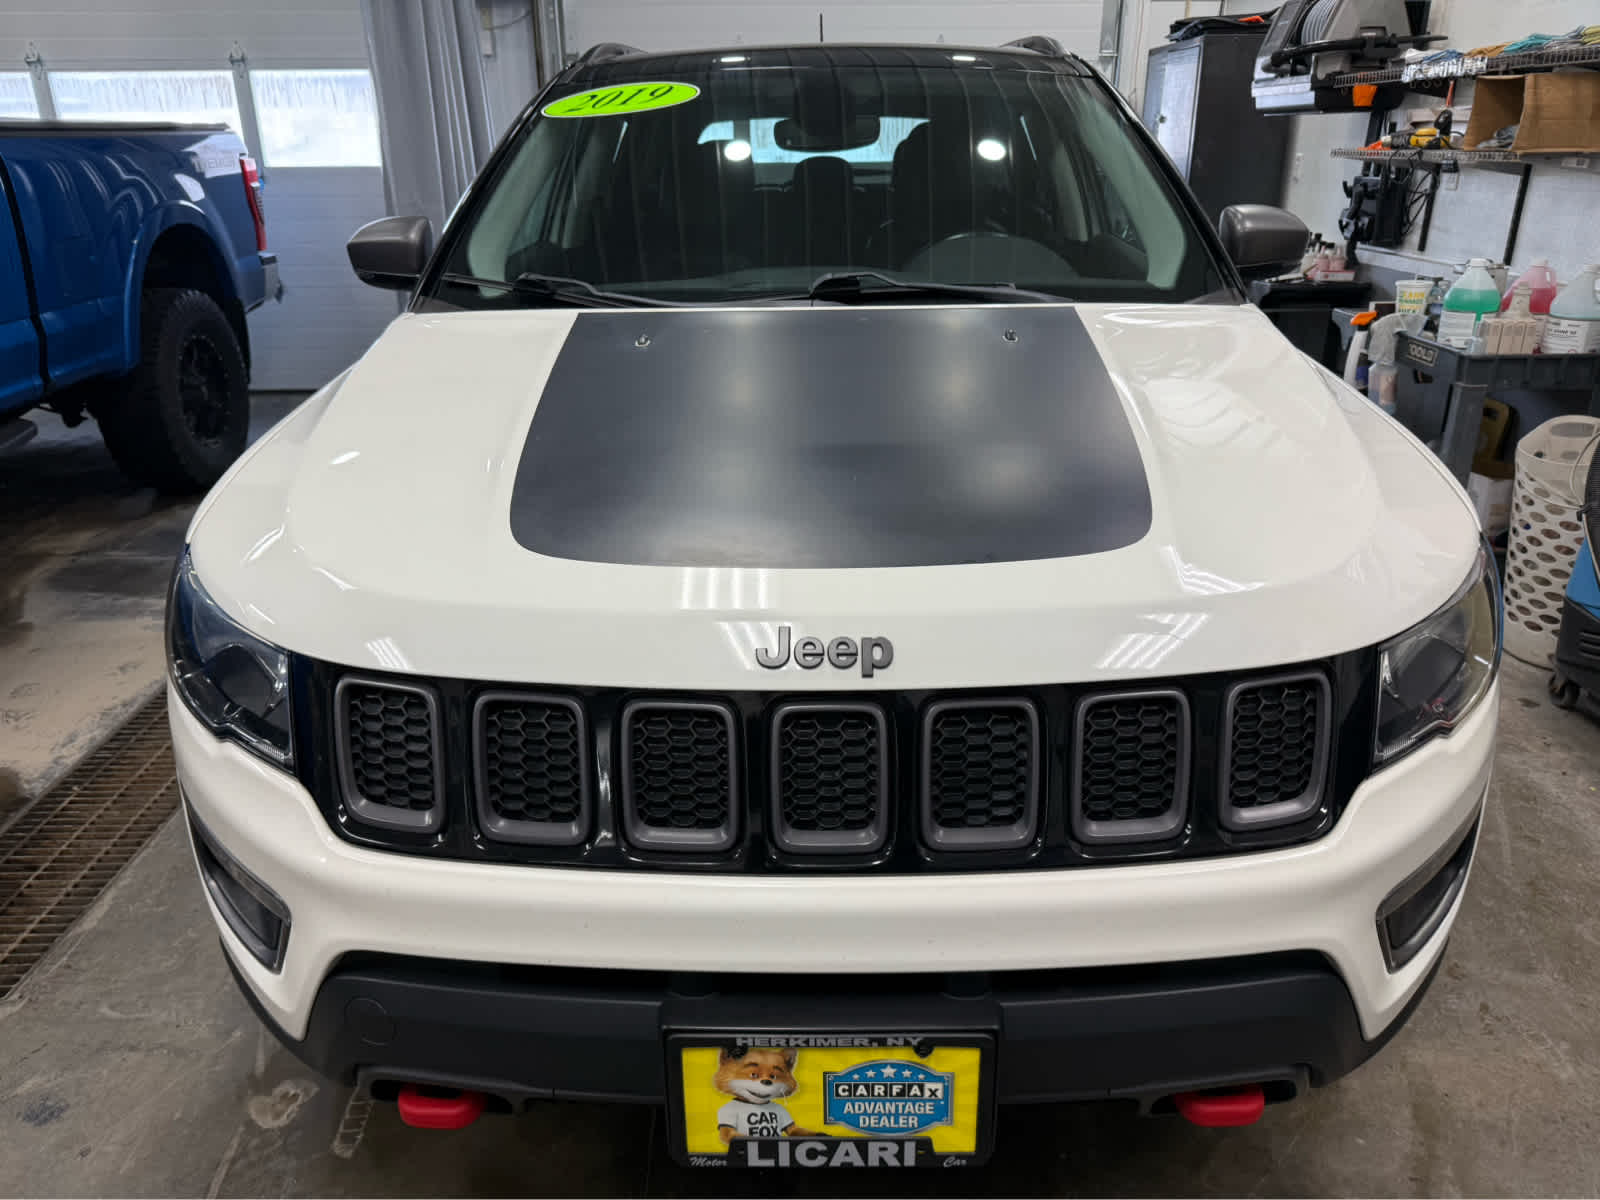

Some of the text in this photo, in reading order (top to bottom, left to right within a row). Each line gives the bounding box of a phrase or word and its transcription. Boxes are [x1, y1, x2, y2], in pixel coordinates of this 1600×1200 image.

[561, 85, 675, 114] 2019
[755, 626, 894, 678] Jeep
[736, 1037, 924, 1047] HERKIMER, NY
[836, 1083, 942, 1098] CARFAX
[843, 1101, 935, 1115] ADVANTAGE
[747, 1111, 778, 1126] CAR
[859, 1115, 919, 1129] DEALER
[748, 1126, 780, 1137] FOX
[747, 1140, 917, 1168] LICARI
[690, 1157, 728, 1168] Motor
[943, 1156, 968, 1168] Car
